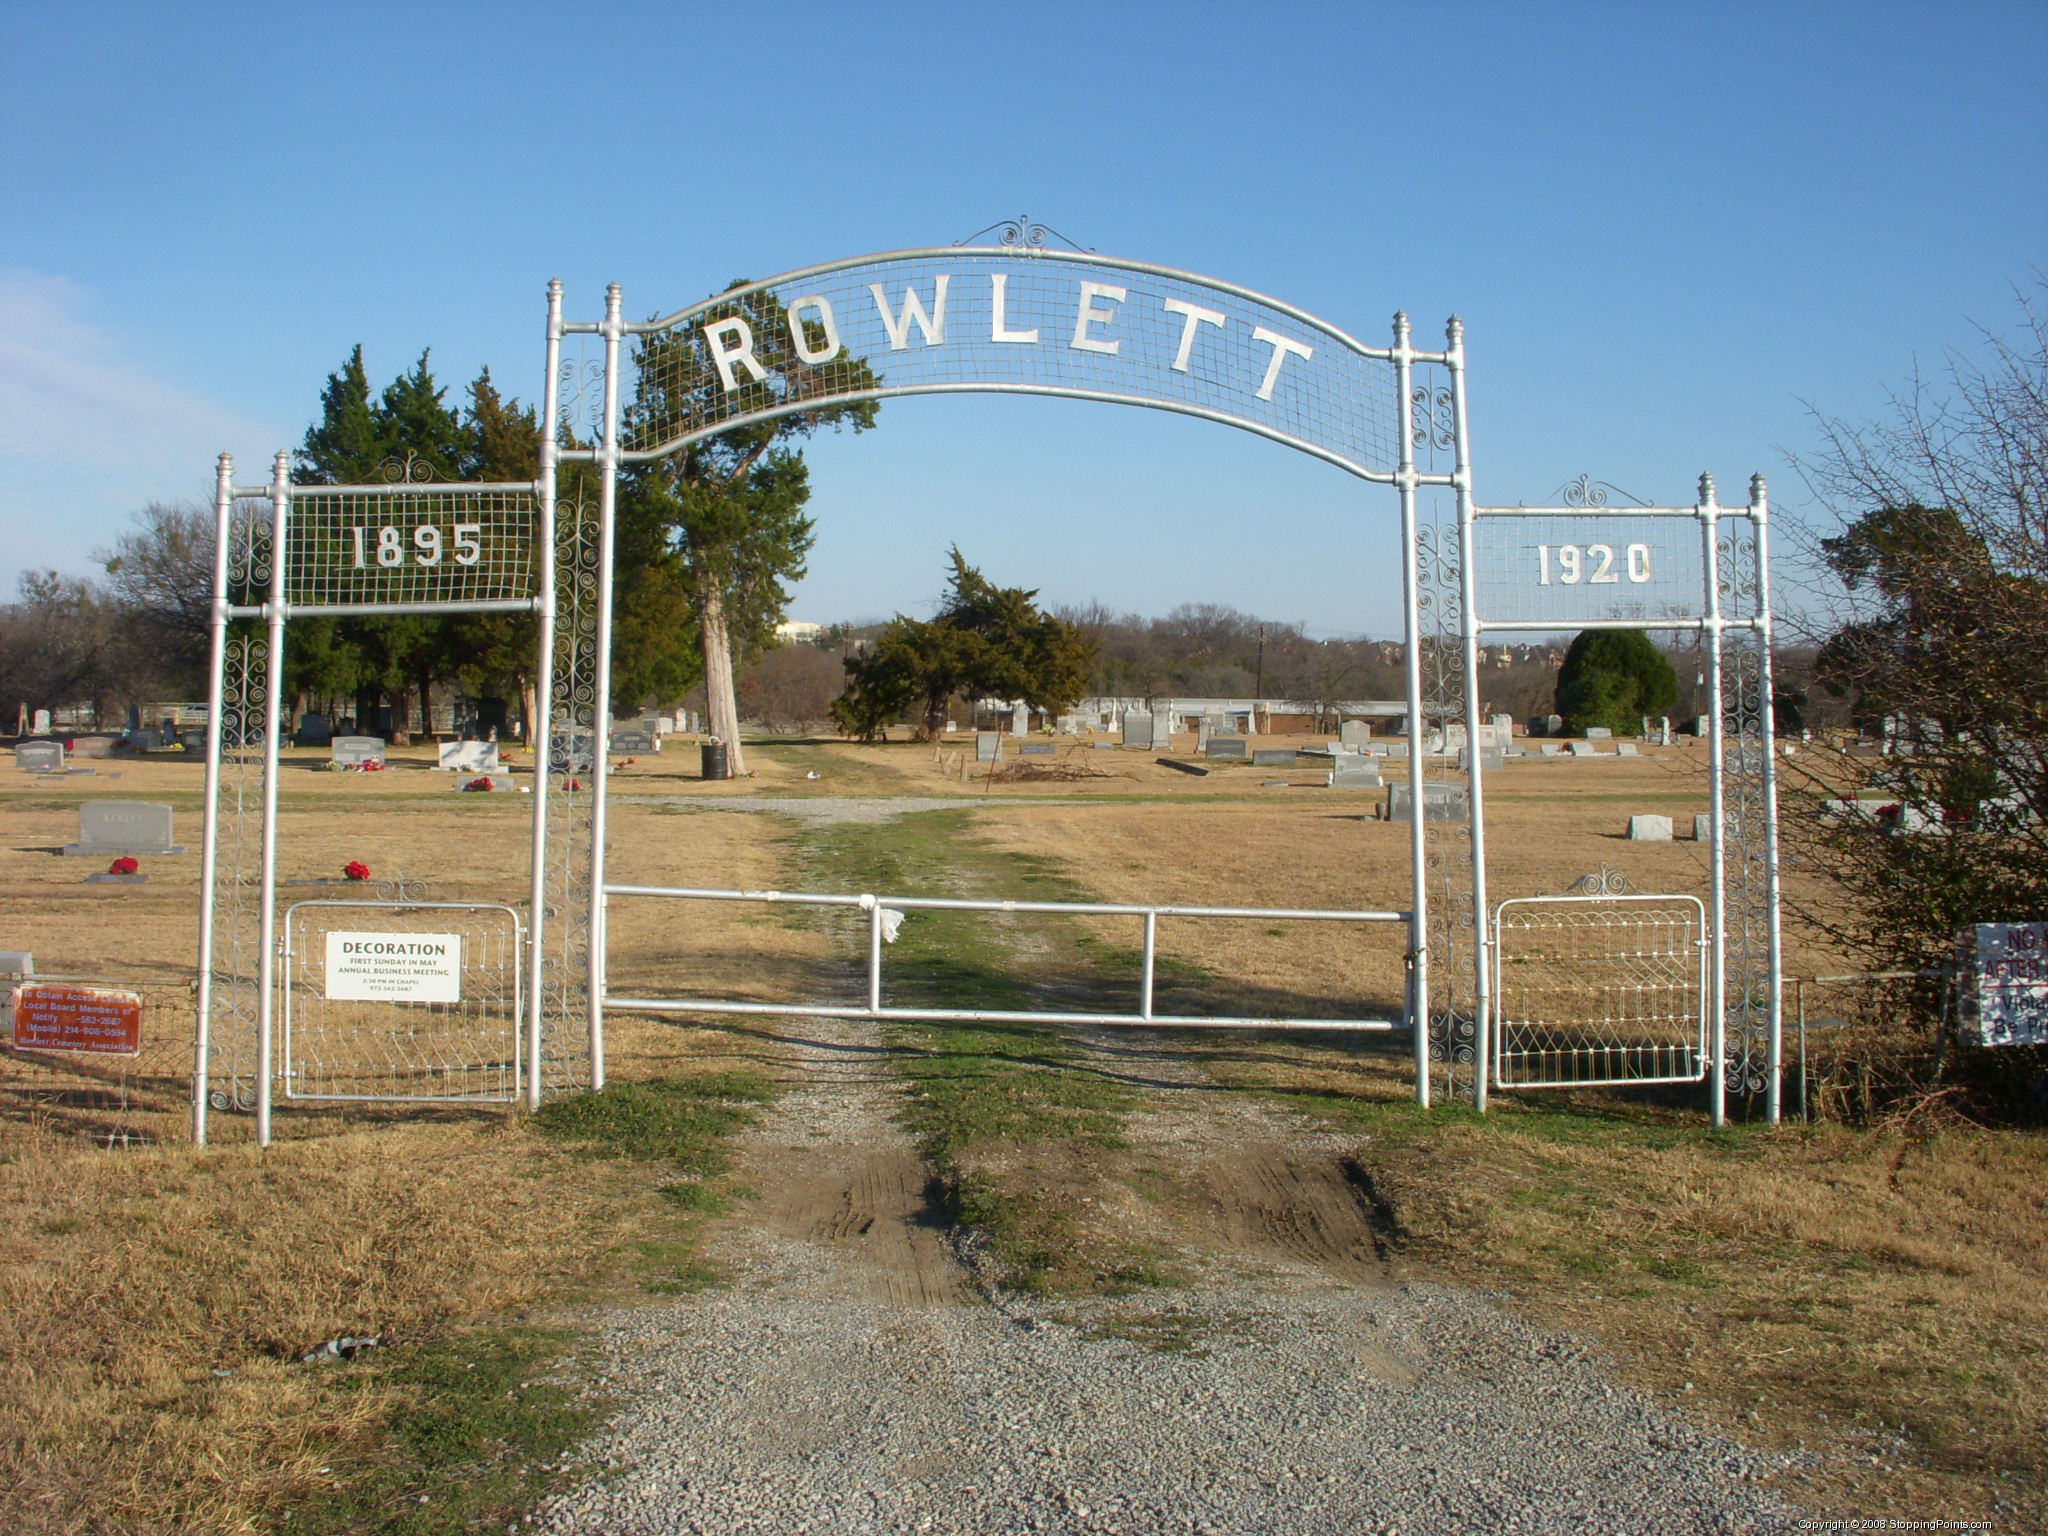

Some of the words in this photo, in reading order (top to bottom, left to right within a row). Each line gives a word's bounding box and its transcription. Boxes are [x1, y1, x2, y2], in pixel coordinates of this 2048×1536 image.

[703, 273, 1313, 401] ROWLETT
[353, 524, 481, 569] 1895
[1538, 543, 1650, 586] 1920
[2007, 928, 2035, 952] NO
[343, 942, 445, 956] DECORATION
[374, 958, 406, 966] SUNDAY
[1985, 959, 2039, 979] AFTER
[36, 992, 63, 1000] Obtain
[51, 1004, 75, 1012] Board
[80, 1005, 118, 1014] Members
[33, 1014, 58, 1023] Notify
[27, 1024, 61, 1034] (Mobile)
[1994, 1019, 2018, 1034] Be
[52, 1039, 87, 1049] Cemetery
